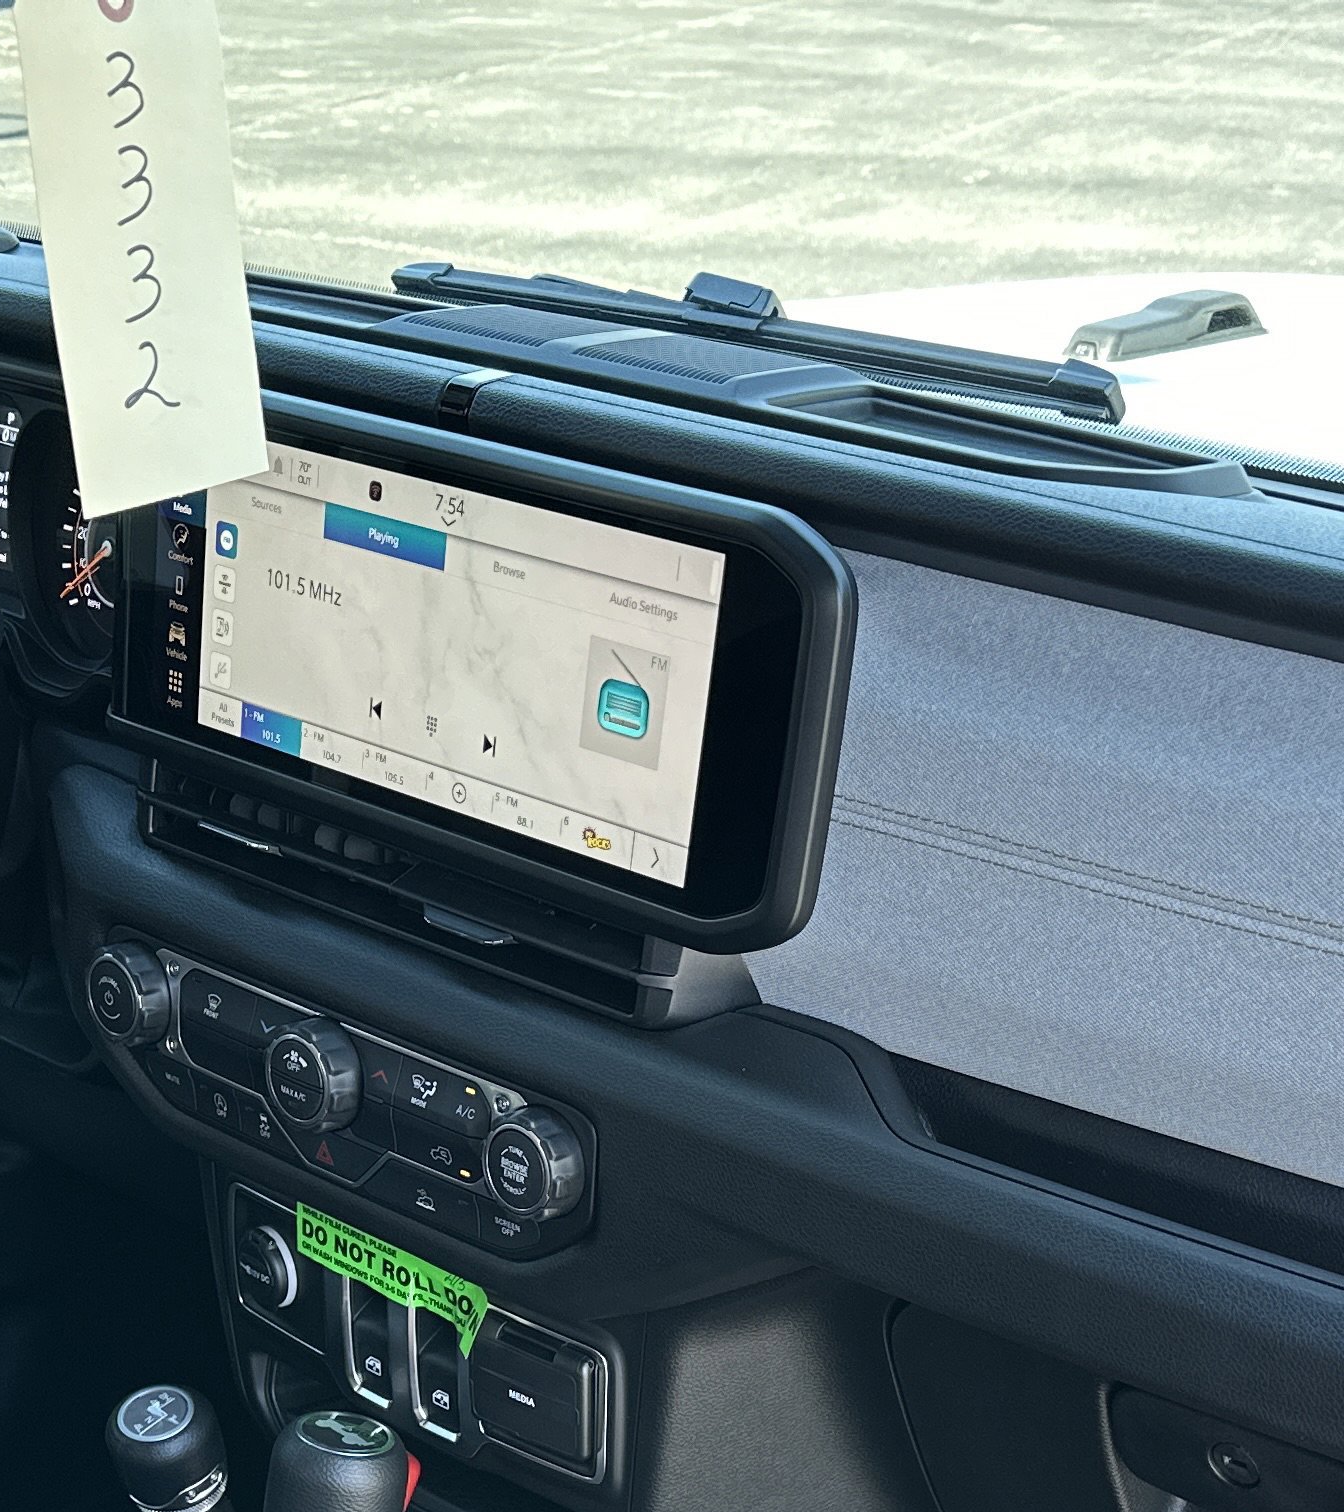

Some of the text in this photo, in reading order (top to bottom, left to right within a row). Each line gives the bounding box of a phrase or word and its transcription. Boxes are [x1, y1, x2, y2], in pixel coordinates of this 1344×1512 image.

[7, 411, 15, 425] P
[298, 474, 312, 486] OUT
[251, 496, 283, 515] Sources
[435, 493, 465, 518] 7:54
[367, 527, 400, 549] Playing
[167, 550, 194, 567] Comfort
[493, 560, 526, 580] Browse
[84, 582, 91, 597] 0
[267, 568, 342, 607] 101.5 MHz
[168, 598, 189, 614] Phone
[609, 592, 678, 622] Audio Settings
[165, 646, 188, 662] Vehicle
[650, 656, 668, 672] FM
[166, 694, 183, 709] Apps
[211, 711, 235, 728] Presets
[262, 729, 281, 744] 101.5
[322, 750, 342, 764] 104.7
[375, 752, 387, 764] FM
[428, 771, 434, 781] 4
[506, 795, 518, 808] FM
[516, 815, 534, 830] 88.1
[563, 816, 569, 826] 6
[203, 1008, 220, 1021] FRONT
[286, 1060, 302, 1073] OFF
[455, 1104, 476, 1120] A/C
[500, 1156, 529, 1177] BROWSE
[503, 1168, 525, 1184] ENTER
[494, 1216, 521, 1233] SCREEN
[501, 1226, 514, 1237] OFF
[324, 1214, 342, 1232] FILM
[368, 1236, 397, 1259] PLEASE
[301, 1217, 328, 1247] DO
[334, 1233, 376, 1270] NOT
[382, 1257, 441, 1297] ROLL
[301, 1241, 312, 1253] OR
[312, 1246, 333, 1263] WASH
[334, 1257, 369, 1281] WINDOWS
[369, 1274, 385, 1288] FOR
[508, 1389, 535, 1407] MEDIA
